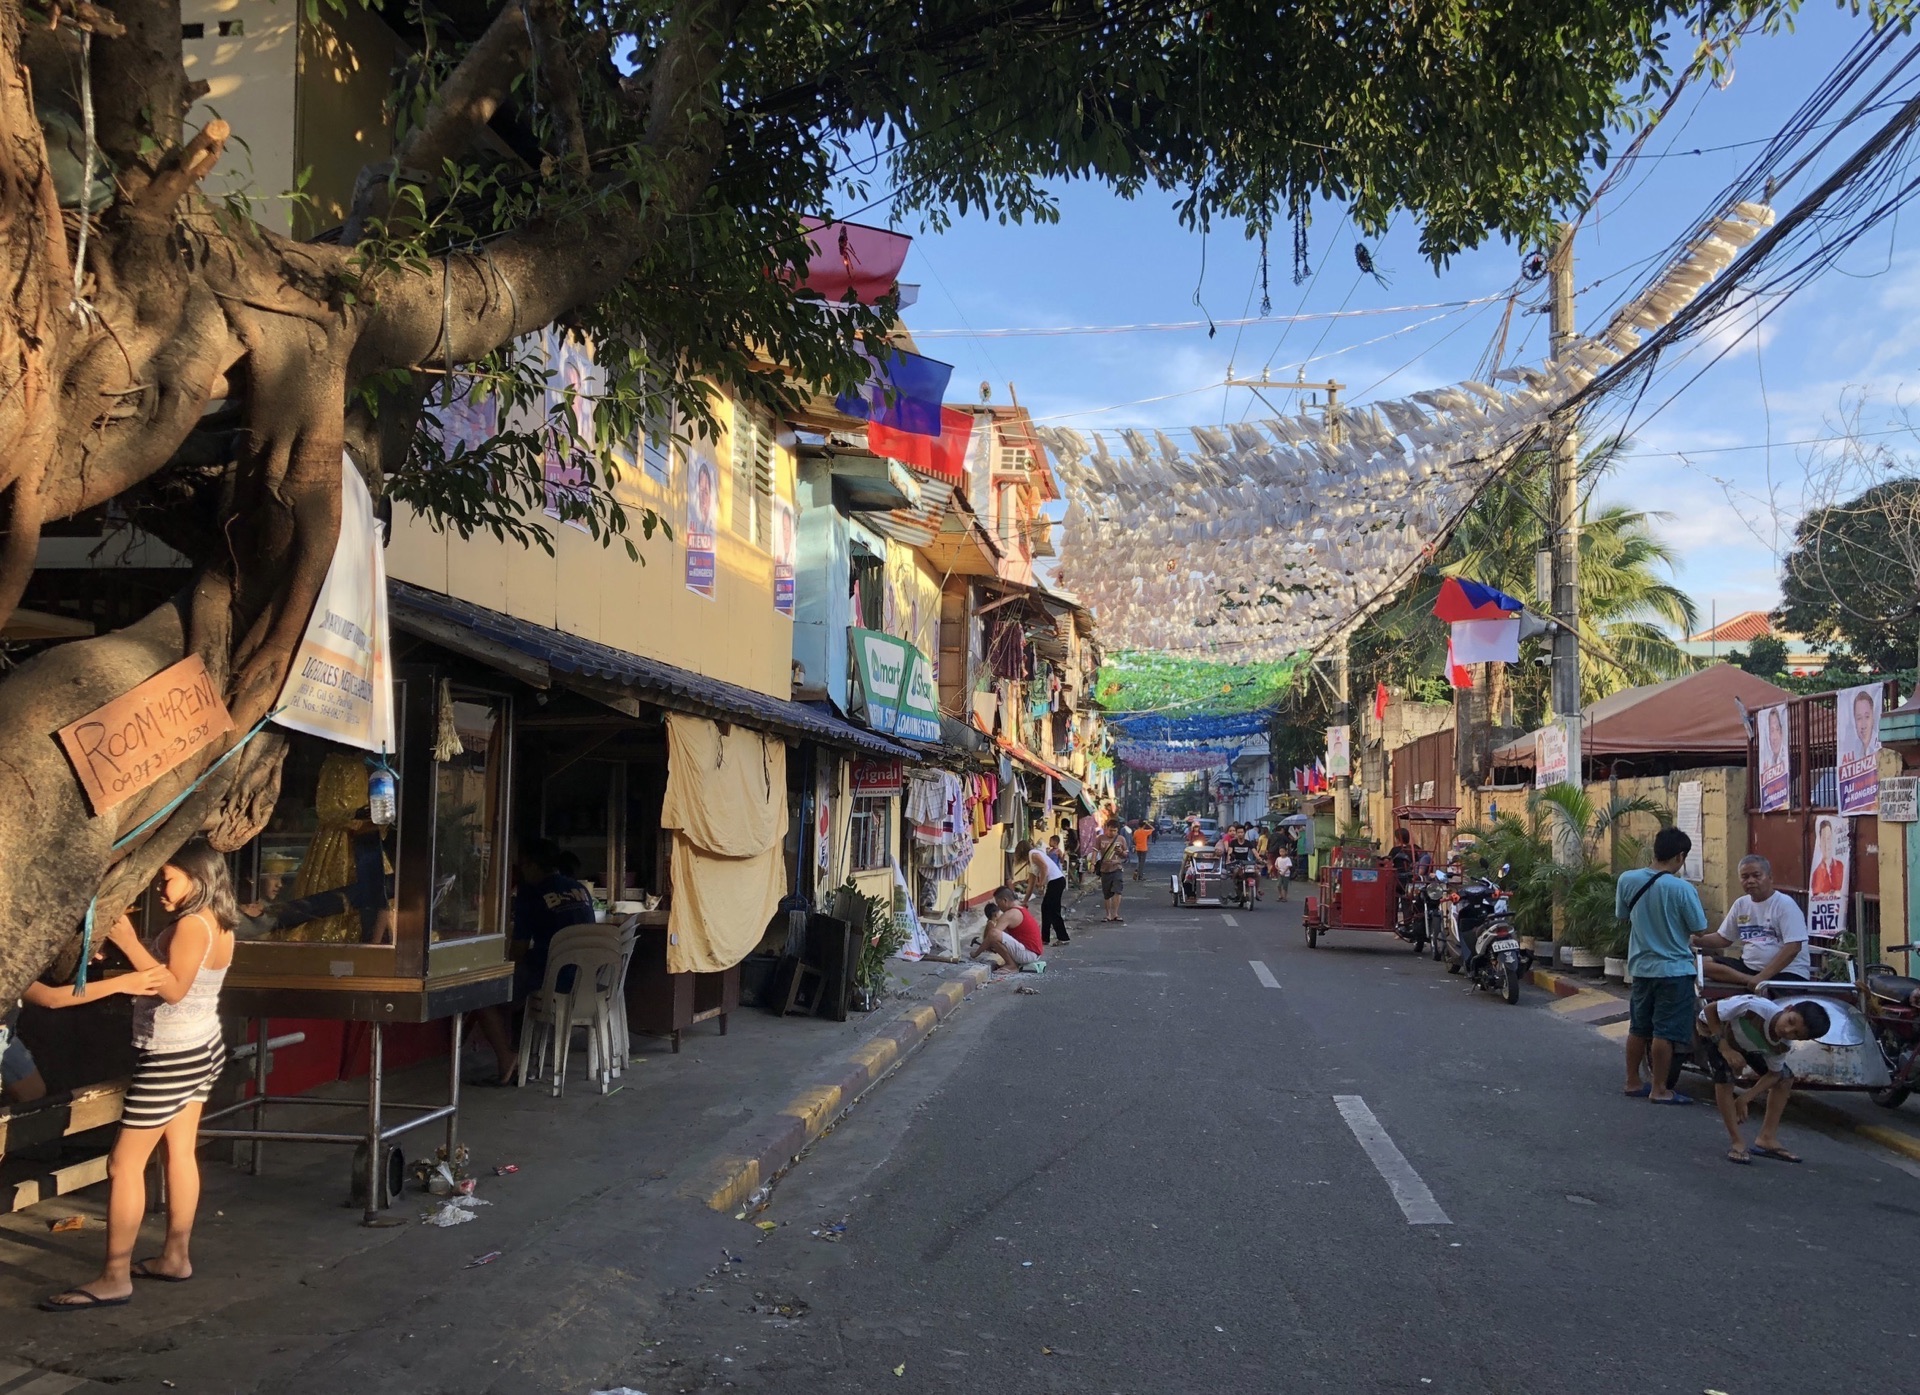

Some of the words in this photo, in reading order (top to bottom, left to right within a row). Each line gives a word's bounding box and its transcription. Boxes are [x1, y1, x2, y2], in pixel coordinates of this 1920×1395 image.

[1842, 750, 1855, 765] ALI
[1841, 754, 1877, 780] ATIENZA
[854, 767, 898, 784] Cignal
[1844, 782, 1855, 794] ALI
